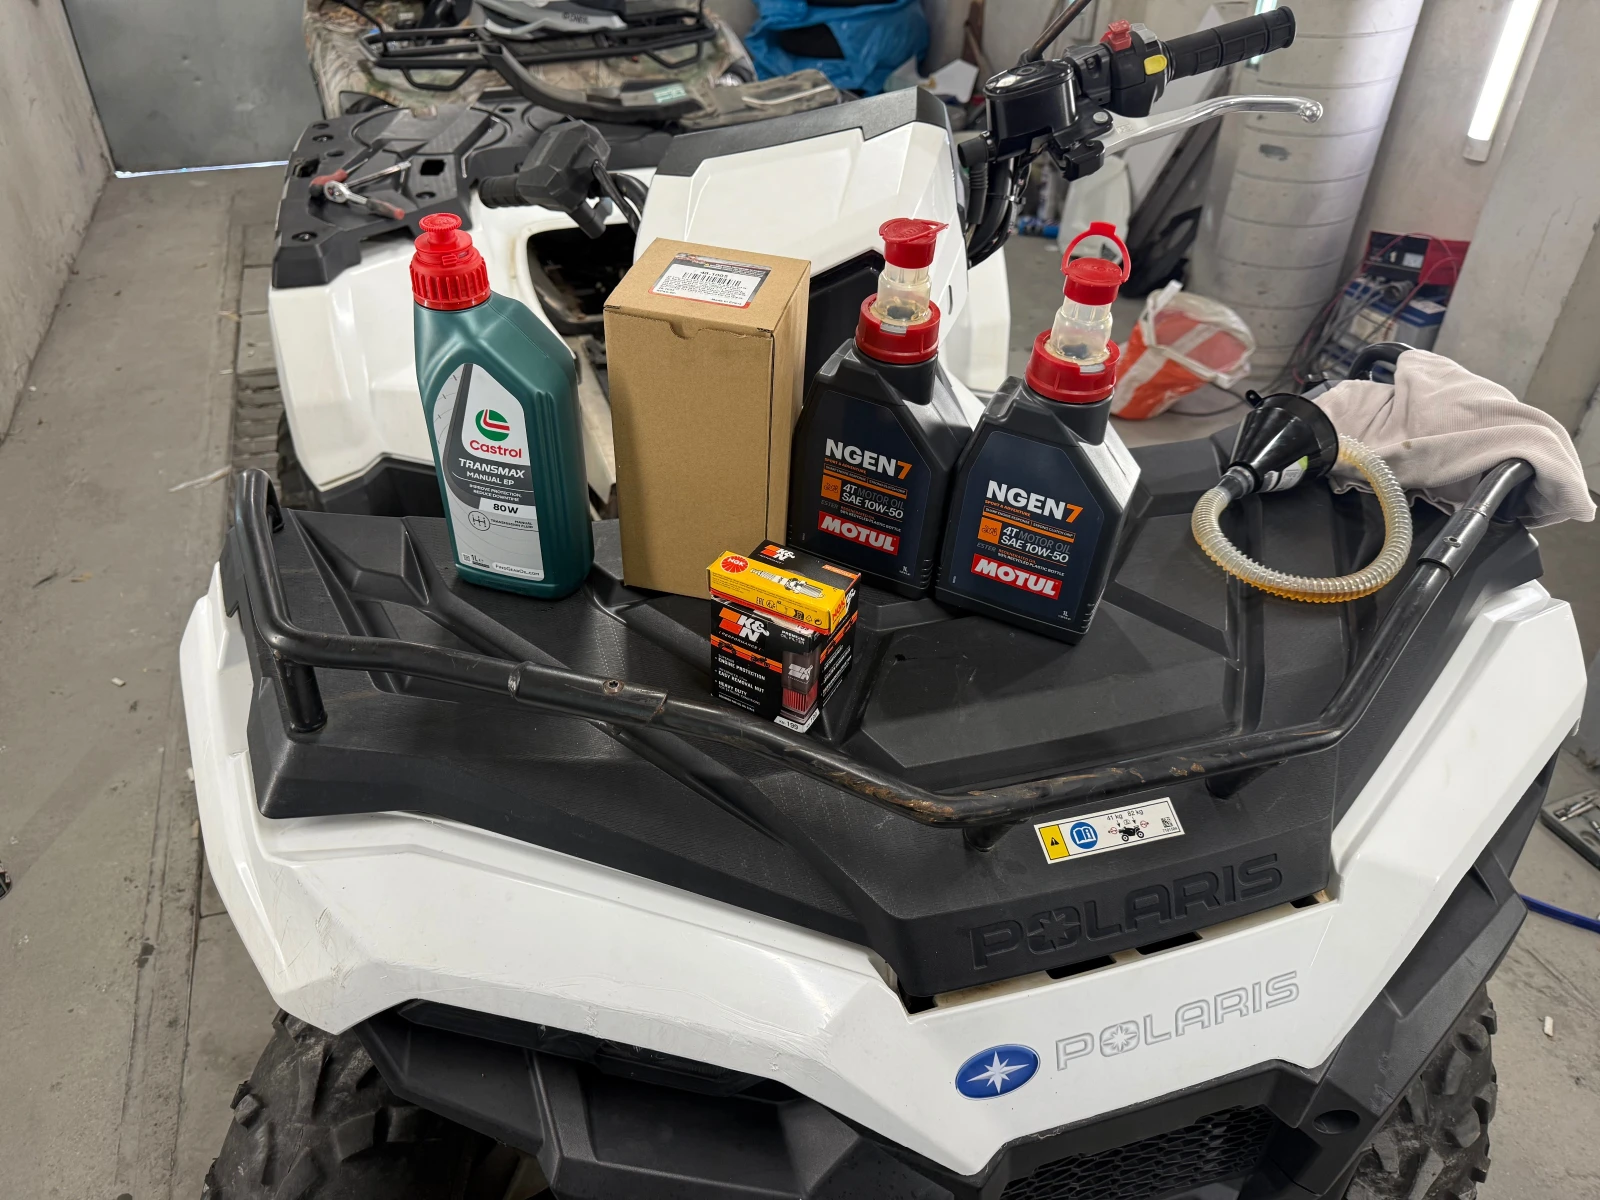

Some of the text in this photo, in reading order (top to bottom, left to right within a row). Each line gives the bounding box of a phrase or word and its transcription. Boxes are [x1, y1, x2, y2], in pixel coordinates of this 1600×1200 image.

[469, 439, 522, 458] Castrol
[825, 438, 913, 480] NGEN7
[458, 458, 526, 479] TRANSMAX
[466, 471, 515, 486] MANUAL EP
[469, 484, 491, 492] IMPROVE
[842, 483, 904, 510] 4T MOTOR OIL
[493, 503, 519, 514] 80W
[820, 499, 839, 510] ESTER
[842, 492, 904, 519] SAE 10W-50
[984, 499, 1000, 508] SPORT
[1004, 505, 1031, 517] ADVENTURE
[986, 480, 1084, 524] NGEN7
[1011, 514, 1030, 525] RESPONSE
[821, 515, 895, 552] MOTUL
[1003, 526, 1072, 555] 4T MOTOR OIL
[773, 548, 796, 562] K&N
[976, 542, 997, 553] ESTER
[1000, 534, 1070, 564] SAE 10W-50
[728, 558, 745, 567] NGK
[1006, 554, 1030, 566] RECYCLED
[1030, 561, 1048, 572] PLASTIC
[1048, 566, 1065, 577] BOTTLE
[974, 558, 1056, 596] MOTUL
[832, 596, 846, 621] NGK
[736, 614, 770, 643] K&N
[788, 636, 806, 646] FILTER
[718, 658, 736, 670] ENGINE
[736, 664, 766, 681] PROTECTION
[718, 670, 730, 680] EASY
[731, 675, 754, 690] REMOVAL
[754, 684, 765, 694] NUT
[718, 680, 748, 696] HEAVY DUTY
[1106, 814, 1114, 822] 41
[1127, 809, 1144, 818] 82 kg
[971, 852, 1284, 971] POLARIS
[1055, 970, 1300, 1072] POLARIS
